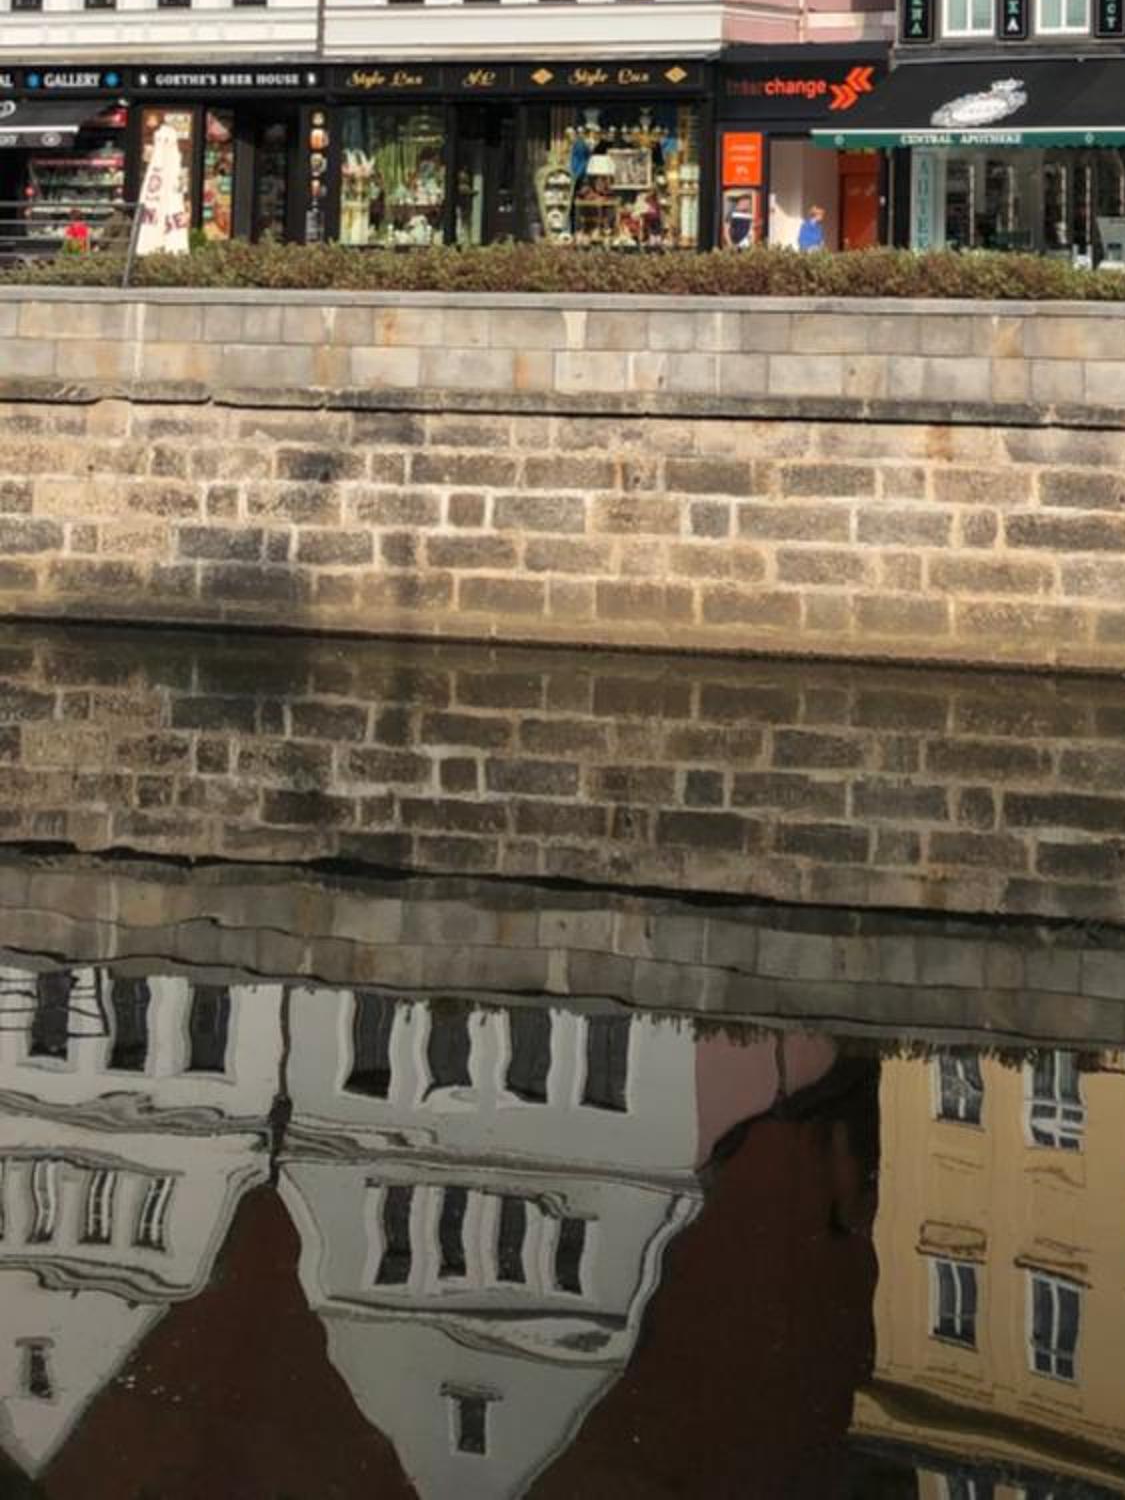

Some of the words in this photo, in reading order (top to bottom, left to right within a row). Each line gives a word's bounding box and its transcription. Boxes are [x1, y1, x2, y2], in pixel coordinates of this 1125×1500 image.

[43, 72, 100, 88] GALLERY
[155, 73, 217, 86] GOETHE'S
[220, 73, 253, 86] BEER
[256, 73, 299, 86] HOUSE
[346, 69, 385, 89] Style
[568, 67, 608, 87] Style
[900, 133, 954, 144] CENTRAL
[960, 132, 1023, 144] APOTHEKE
